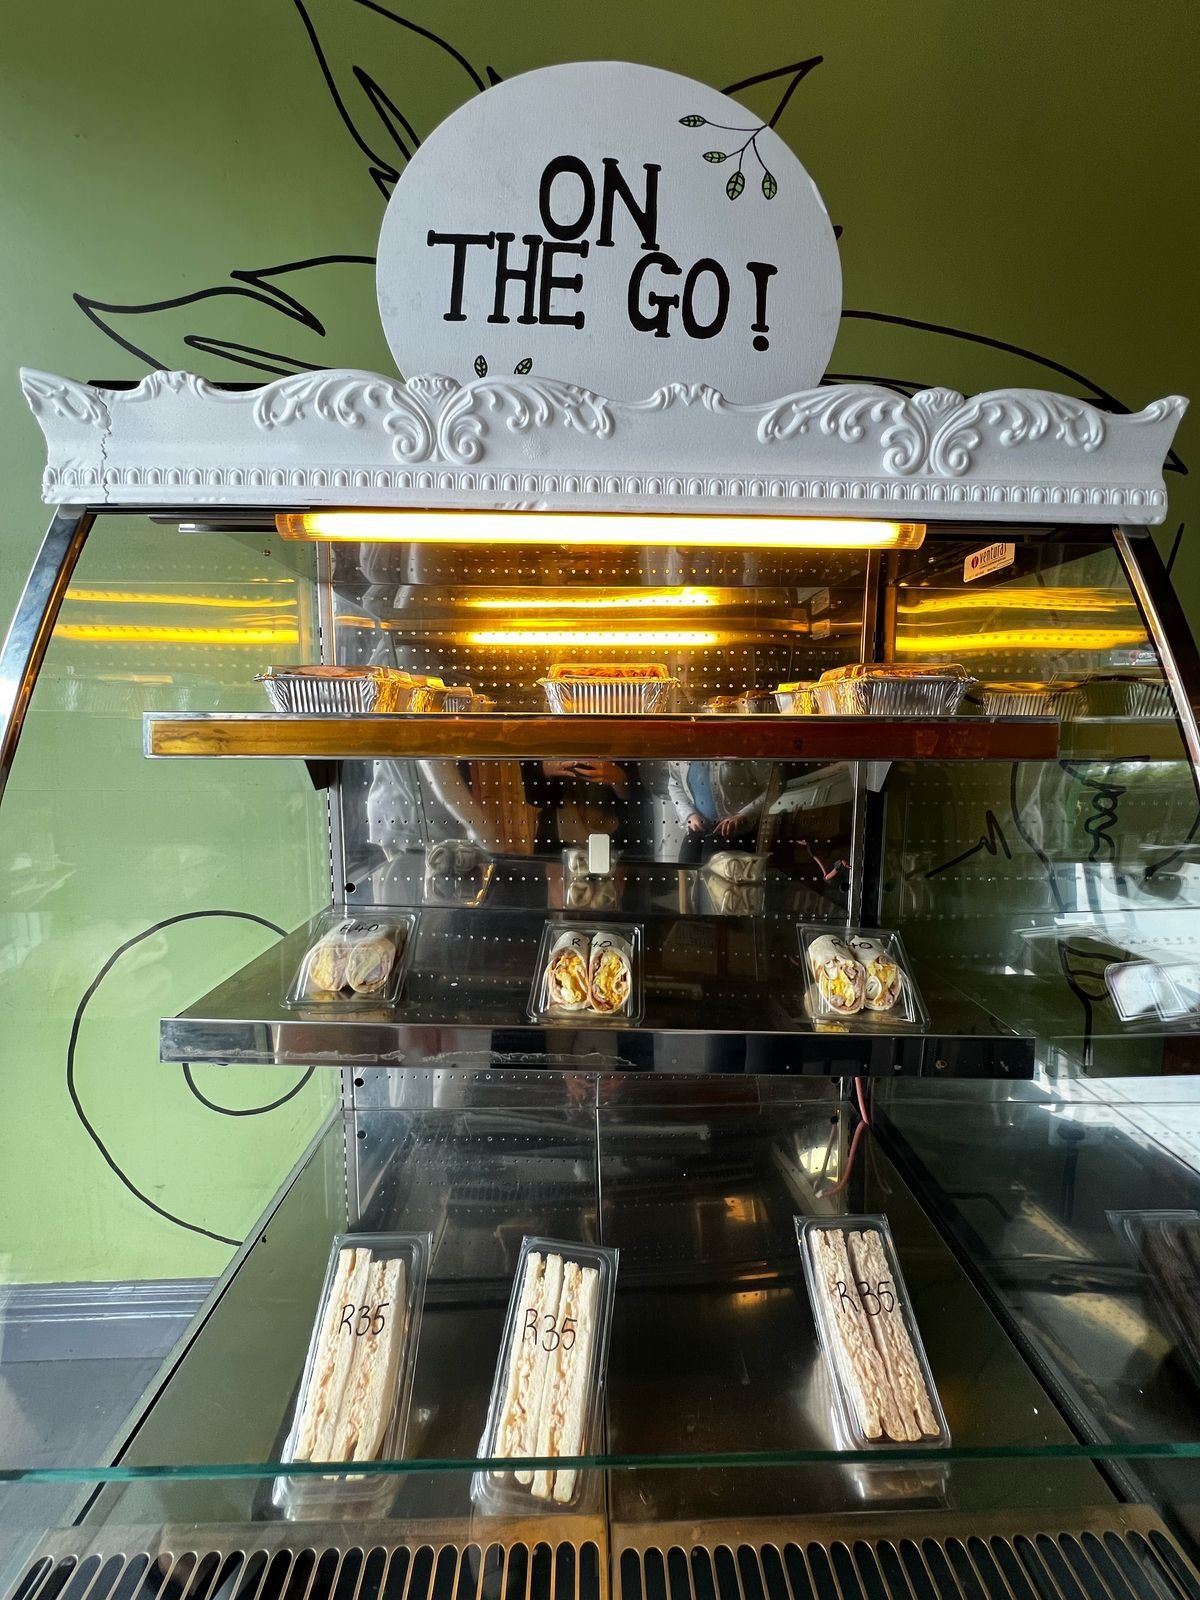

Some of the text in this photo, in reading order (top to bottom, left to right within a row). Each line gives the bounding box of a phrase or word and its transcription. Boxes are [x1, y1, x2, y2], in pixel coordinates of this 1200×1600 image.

[540, 155, 661, 250] ON
[427, 230, 589, 329] THE
[338, 1302, 390, 1336] R35
[836, 1280, 895, 1316] R35
[521, 1308, 578, 1351] R35
